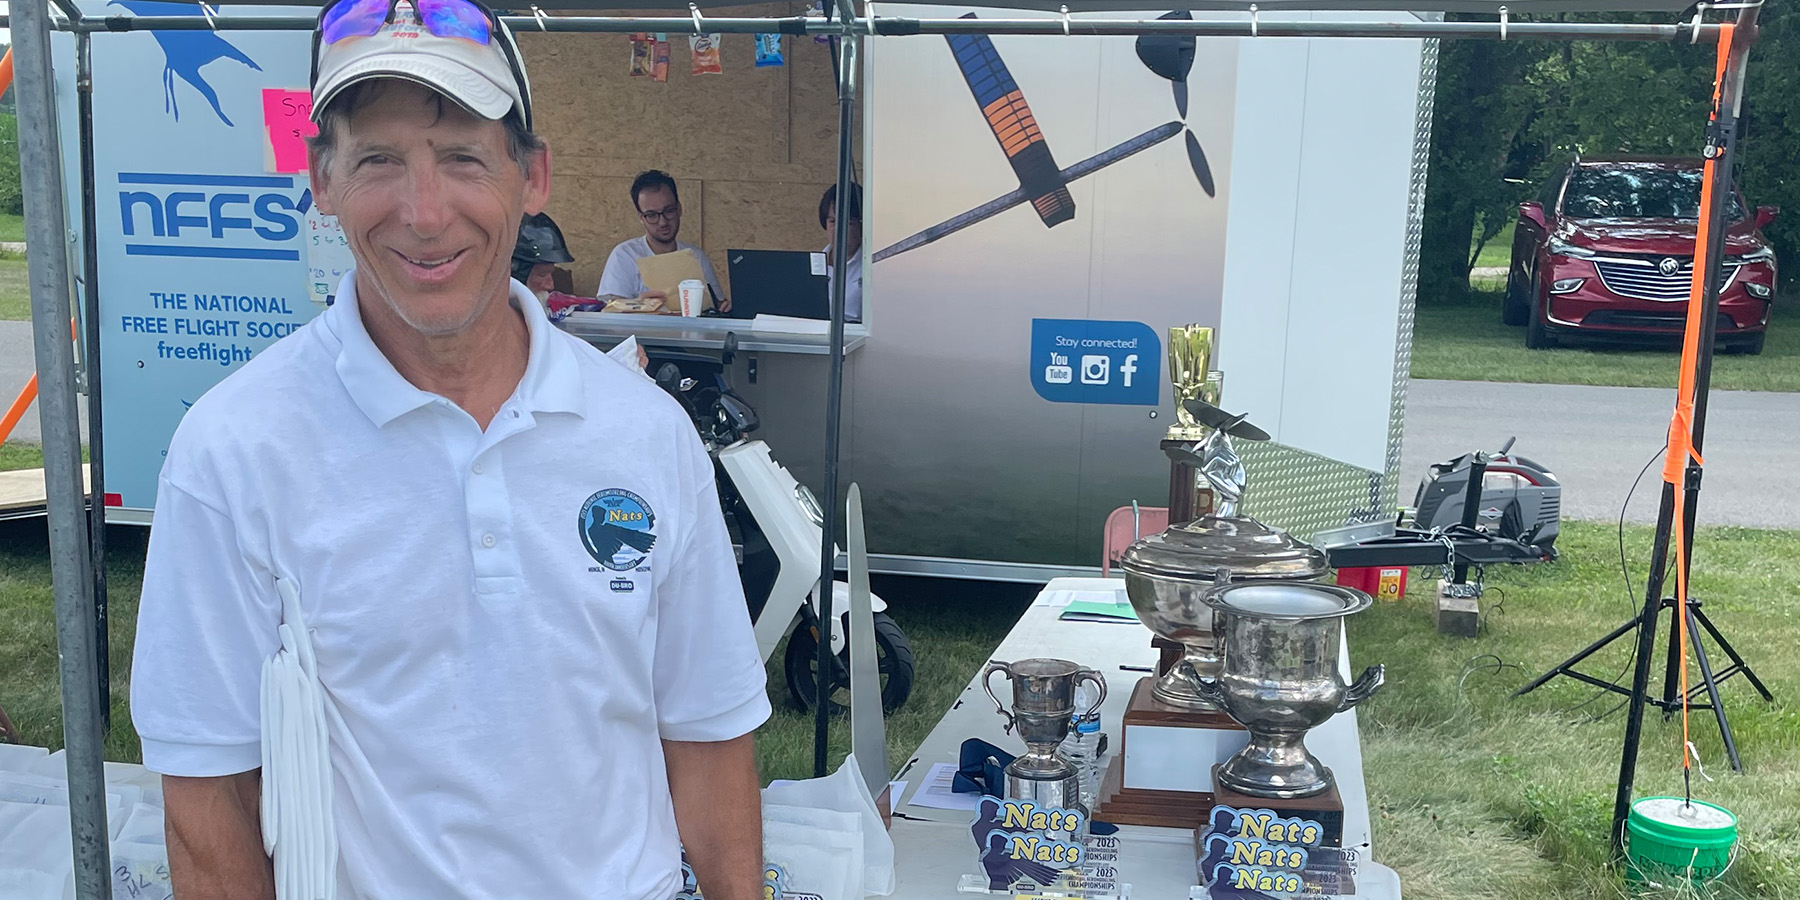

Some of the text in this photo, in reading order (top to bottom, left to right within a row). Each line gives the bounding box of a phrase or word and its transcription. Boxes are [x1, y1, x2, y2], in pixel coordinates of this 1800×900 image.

[150, 292, 293, 315] THE NATIONAL
[121, 316, 168, 334] FREE
[174, 318, 240, 338] FLIGHT
[1055, 335, 1138, 349] Stay connected!
[157, 341, 252, 367] freeflight
[1050, 352, 1068, 366] You
[1049, 368, 1068, 379] Tube
[608, 508, 644, 522] Nats
[1001, 802, 1079, 833] Nats
[1237, 813, 1318, 845] Nats
[1009, 836, 1081, 864] Nats
[1096, 837, 1115, 848] 2023
[1229, 840, 1304, 869] Nats
[1095, 868, 1114, 878] 2023
[1233, 868, 1300, 893] Nats
[1068, 880, 1116, 890] CHAMPIONSHIPS
